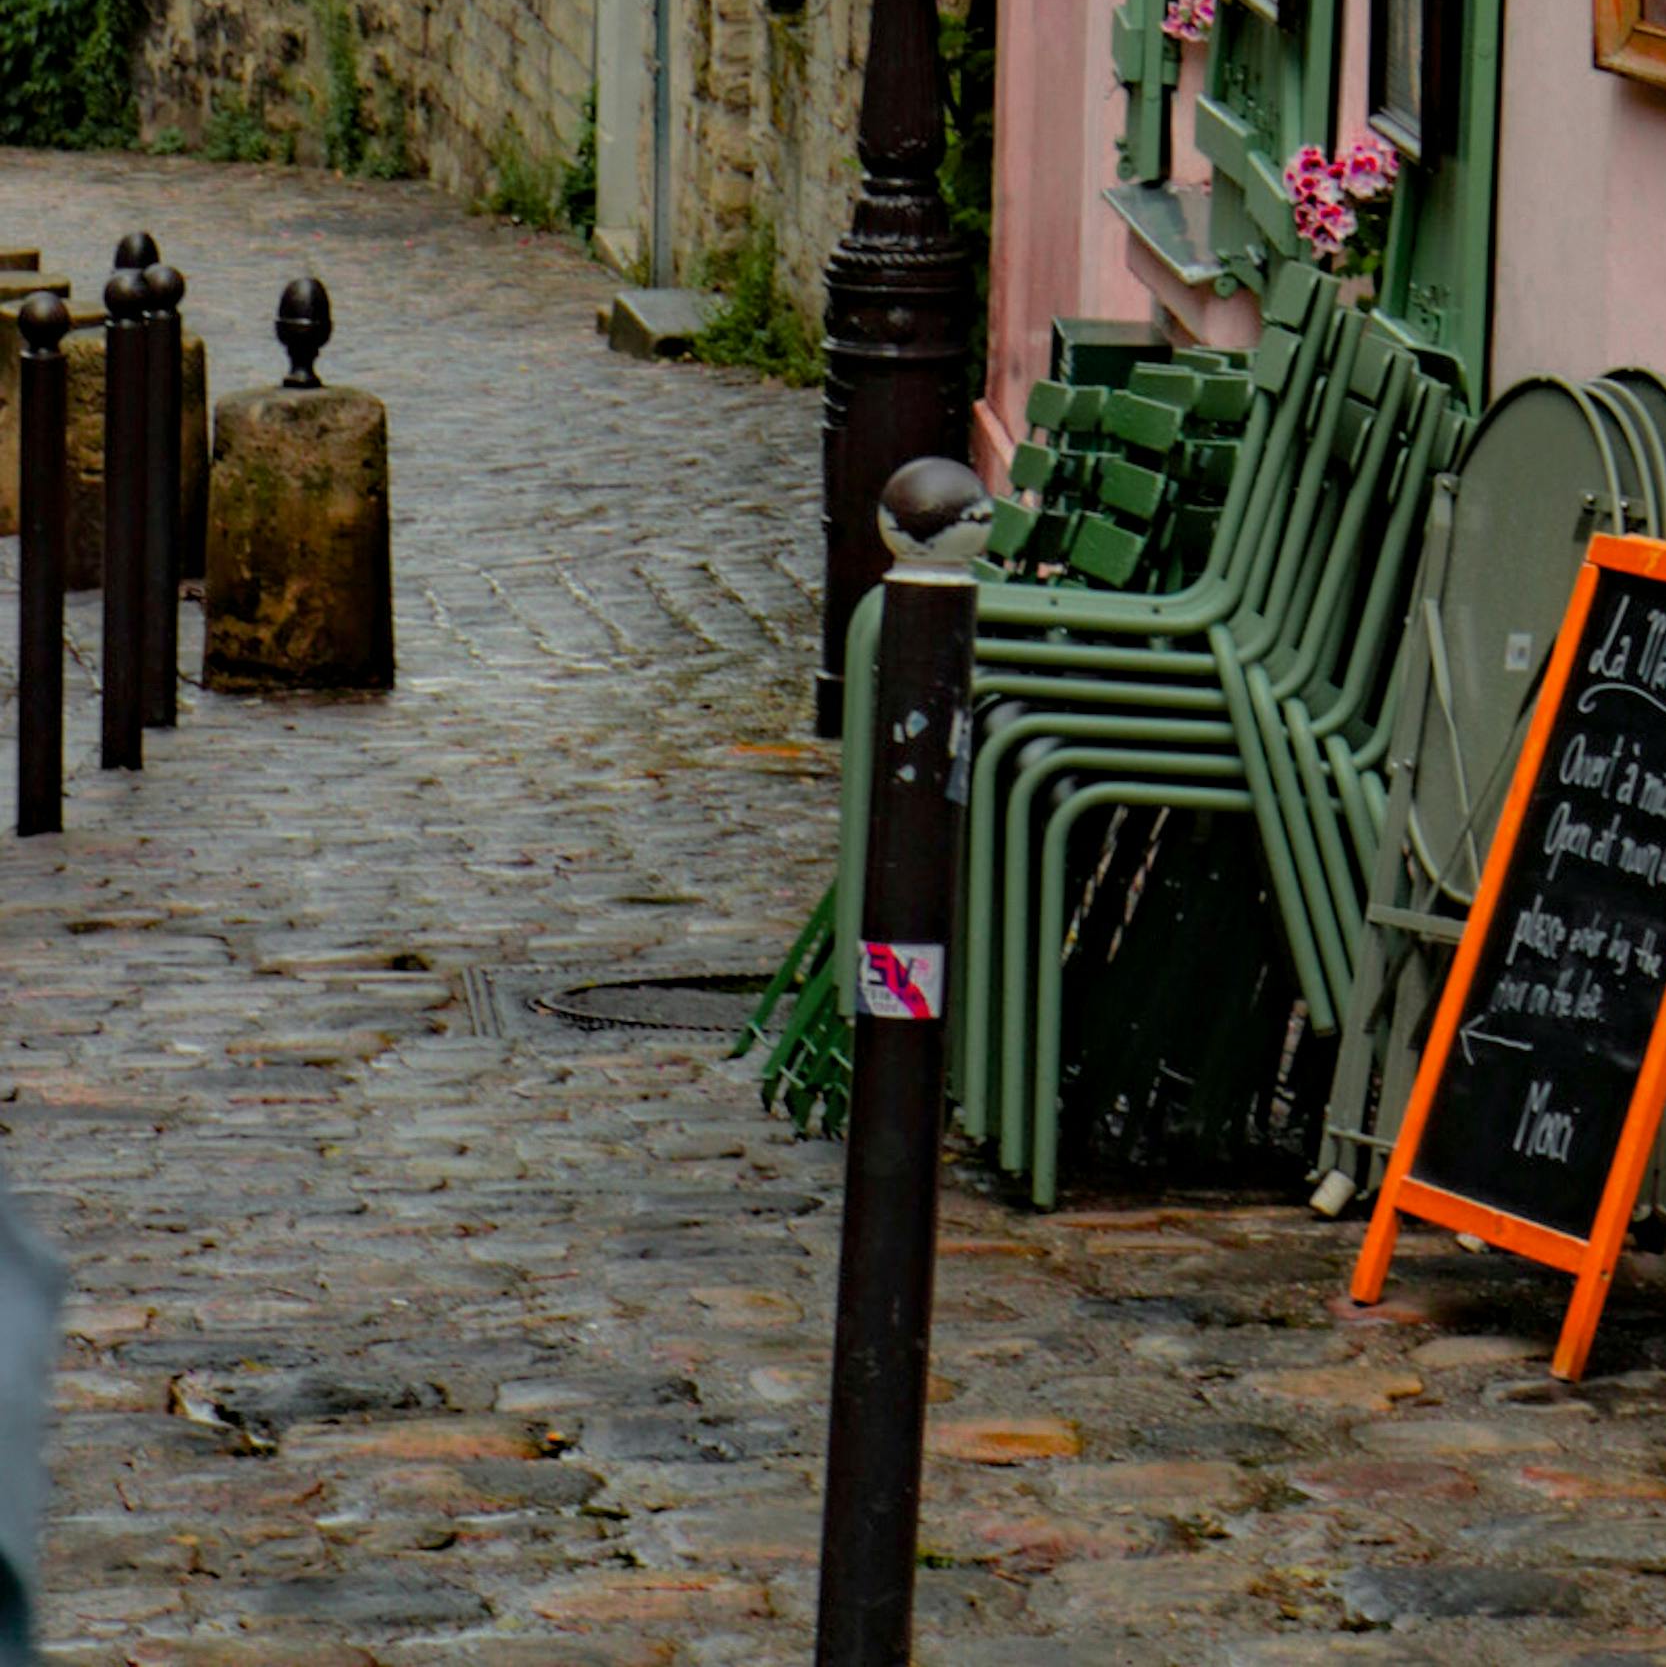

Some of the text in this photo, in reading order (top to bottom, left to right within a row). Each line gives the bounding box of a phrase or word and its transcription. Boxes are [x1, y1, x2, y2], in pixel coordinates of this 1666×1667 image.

[1588, 594, 1633, 680] La
[1559, 733, 1625, 799] Ouvert
[1616, 743, 1641, 805] à
[1544, 801, 1593, 881] Open
[1590, 814, 1622, 866] at
[1506, 893, 1568, 965] please
[1607, 921, 1632, 975] by
[1634, 927, 1663, 979] the
[1513, 1079, 1581, 1164] Merci
